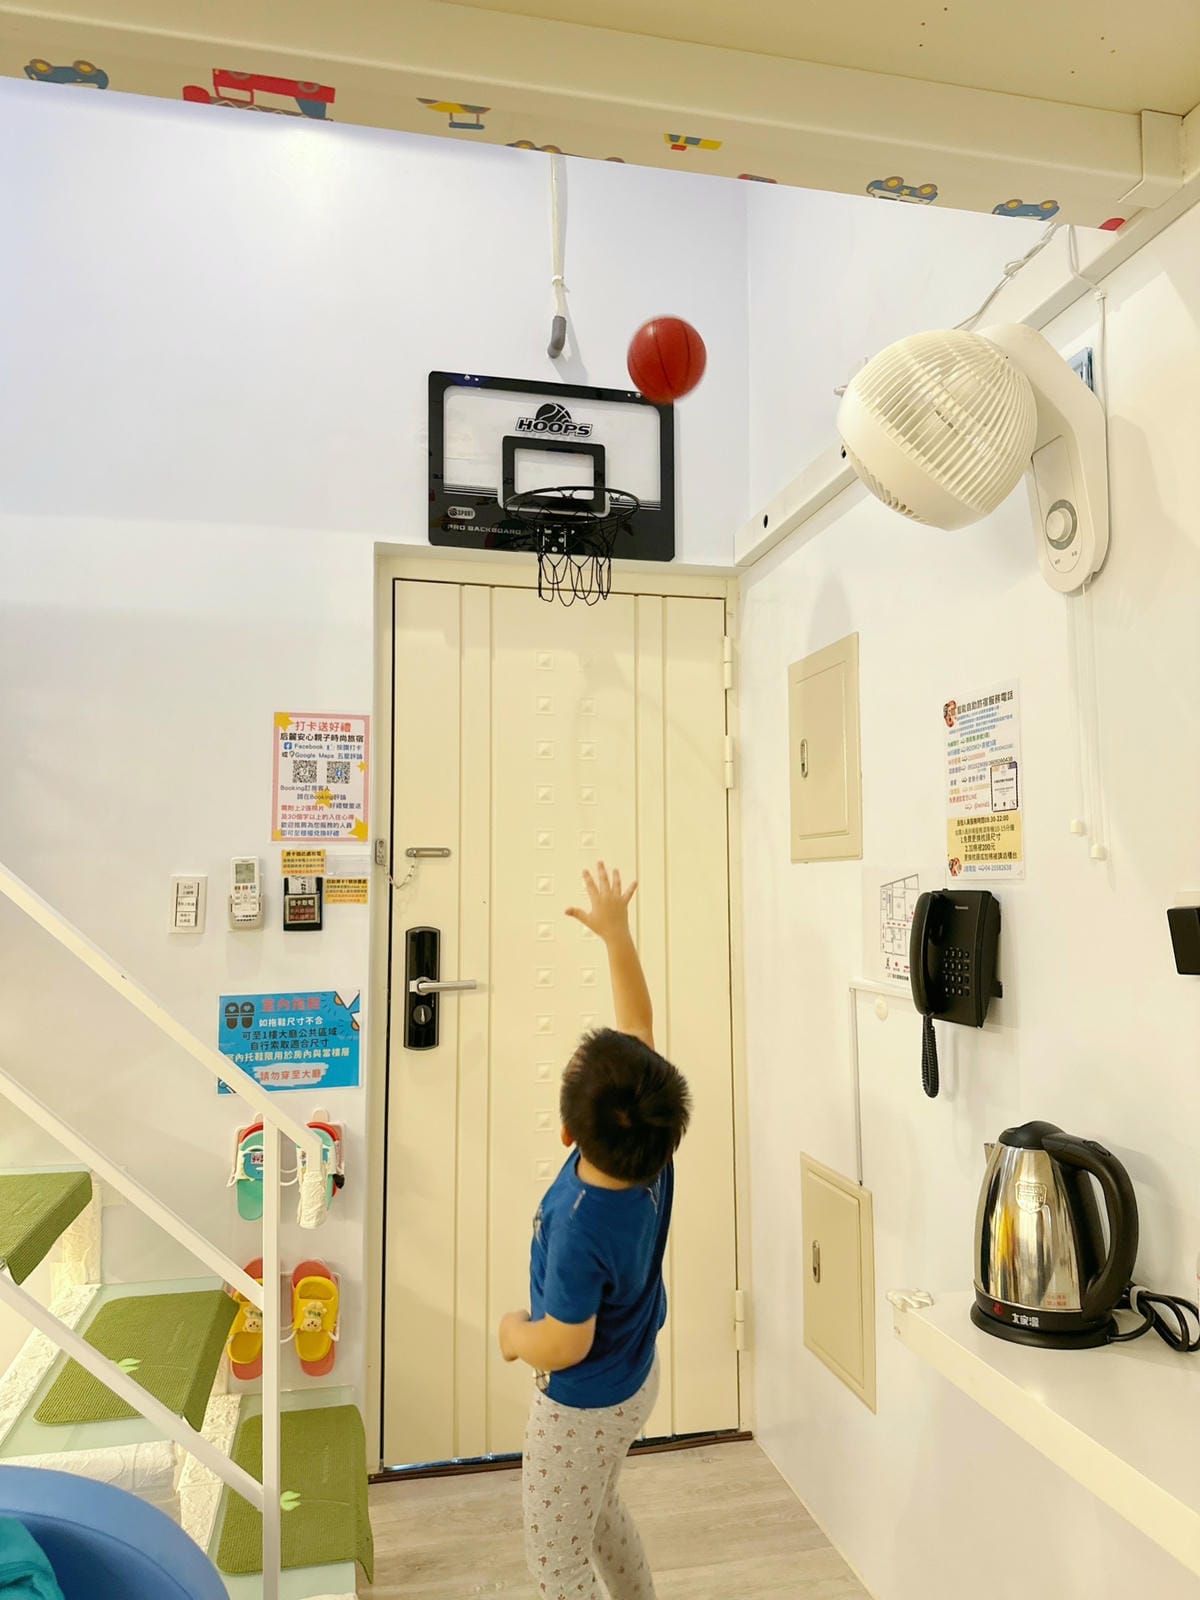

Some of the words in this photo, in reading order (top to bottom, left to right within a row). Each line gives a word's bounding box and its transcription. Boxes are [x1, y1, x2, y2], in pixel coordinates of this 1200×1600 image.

[516, 416, 592, 437] HOOPS
[295, 721, 351, 732] 打卡送好禮
[259, 1016, 324, 1027] 如拖鞋尺寸不合
[242, 1027, 338, 1040] 可至1樓大廳公共區域
[260, 1069, 322, 1081] 請勿穿至大廳
